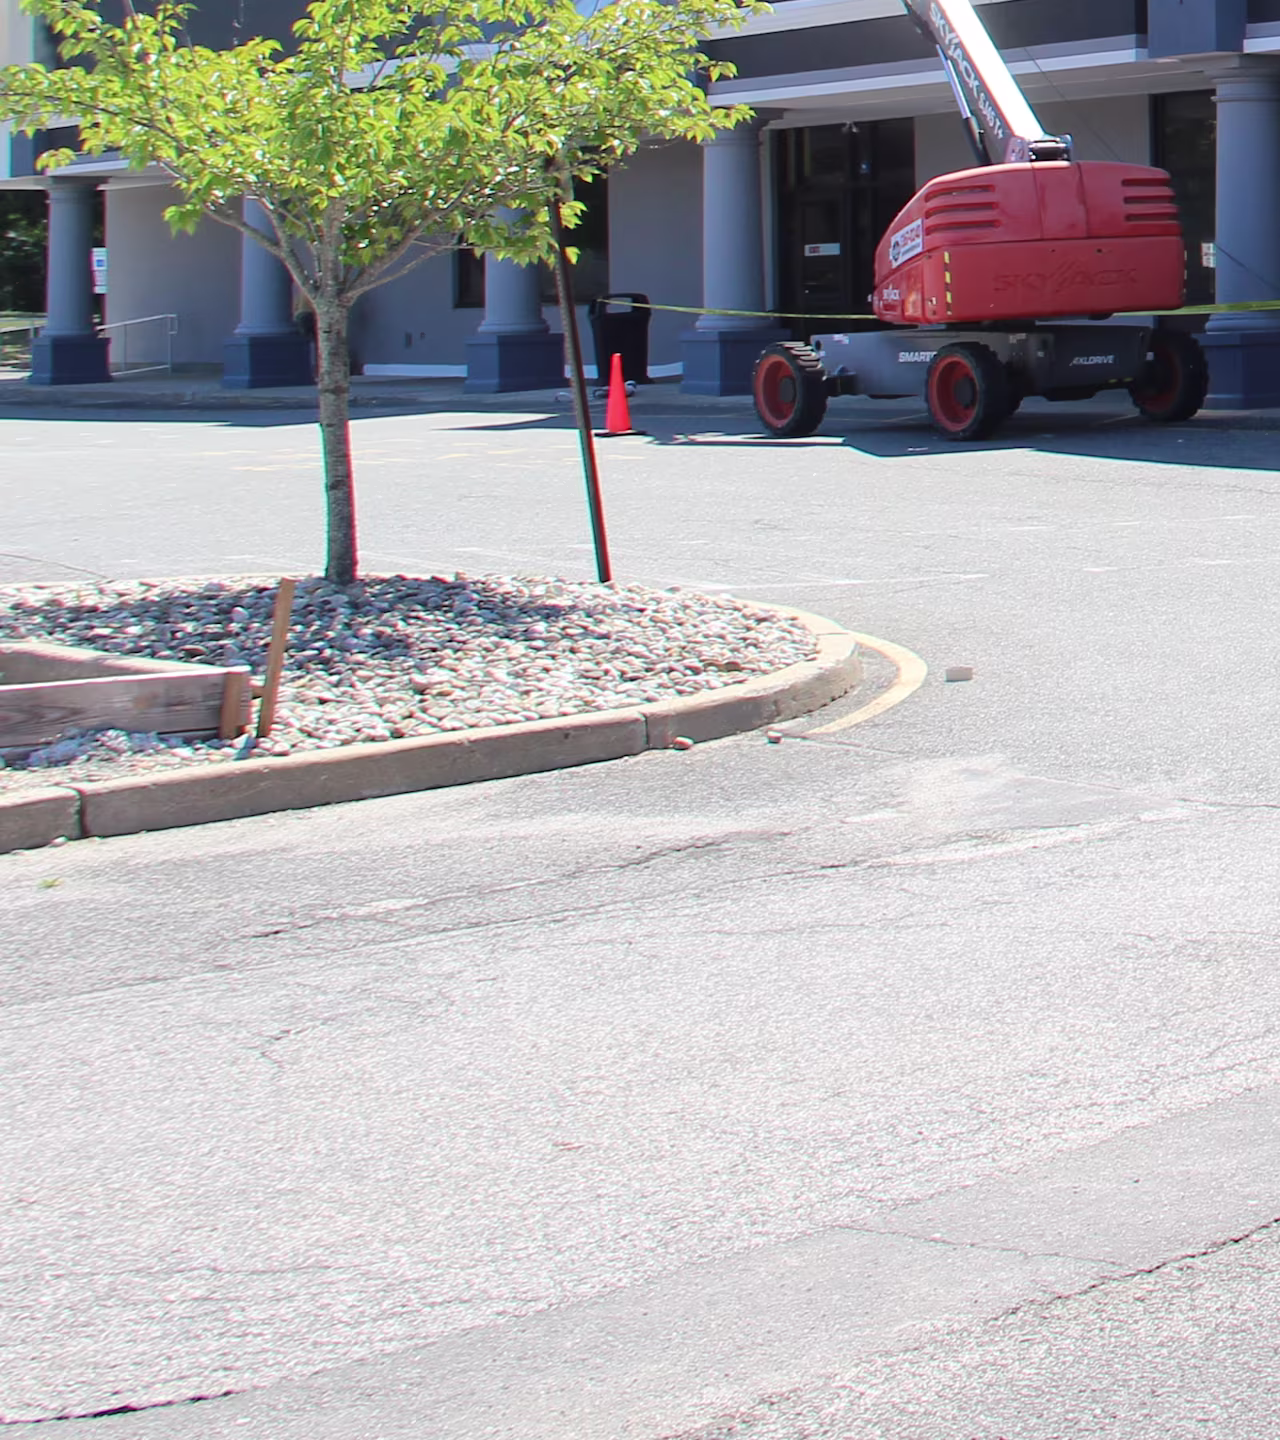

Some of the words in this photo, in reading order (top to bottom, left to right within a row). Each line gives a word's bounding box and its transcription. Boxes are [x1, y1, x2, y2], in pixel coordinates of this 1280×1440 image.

[930, 1, 980, 99] SKYJACK
[993, 260, 1138, 294] SKYJACK
[898, 351, 938, 363] SMART
